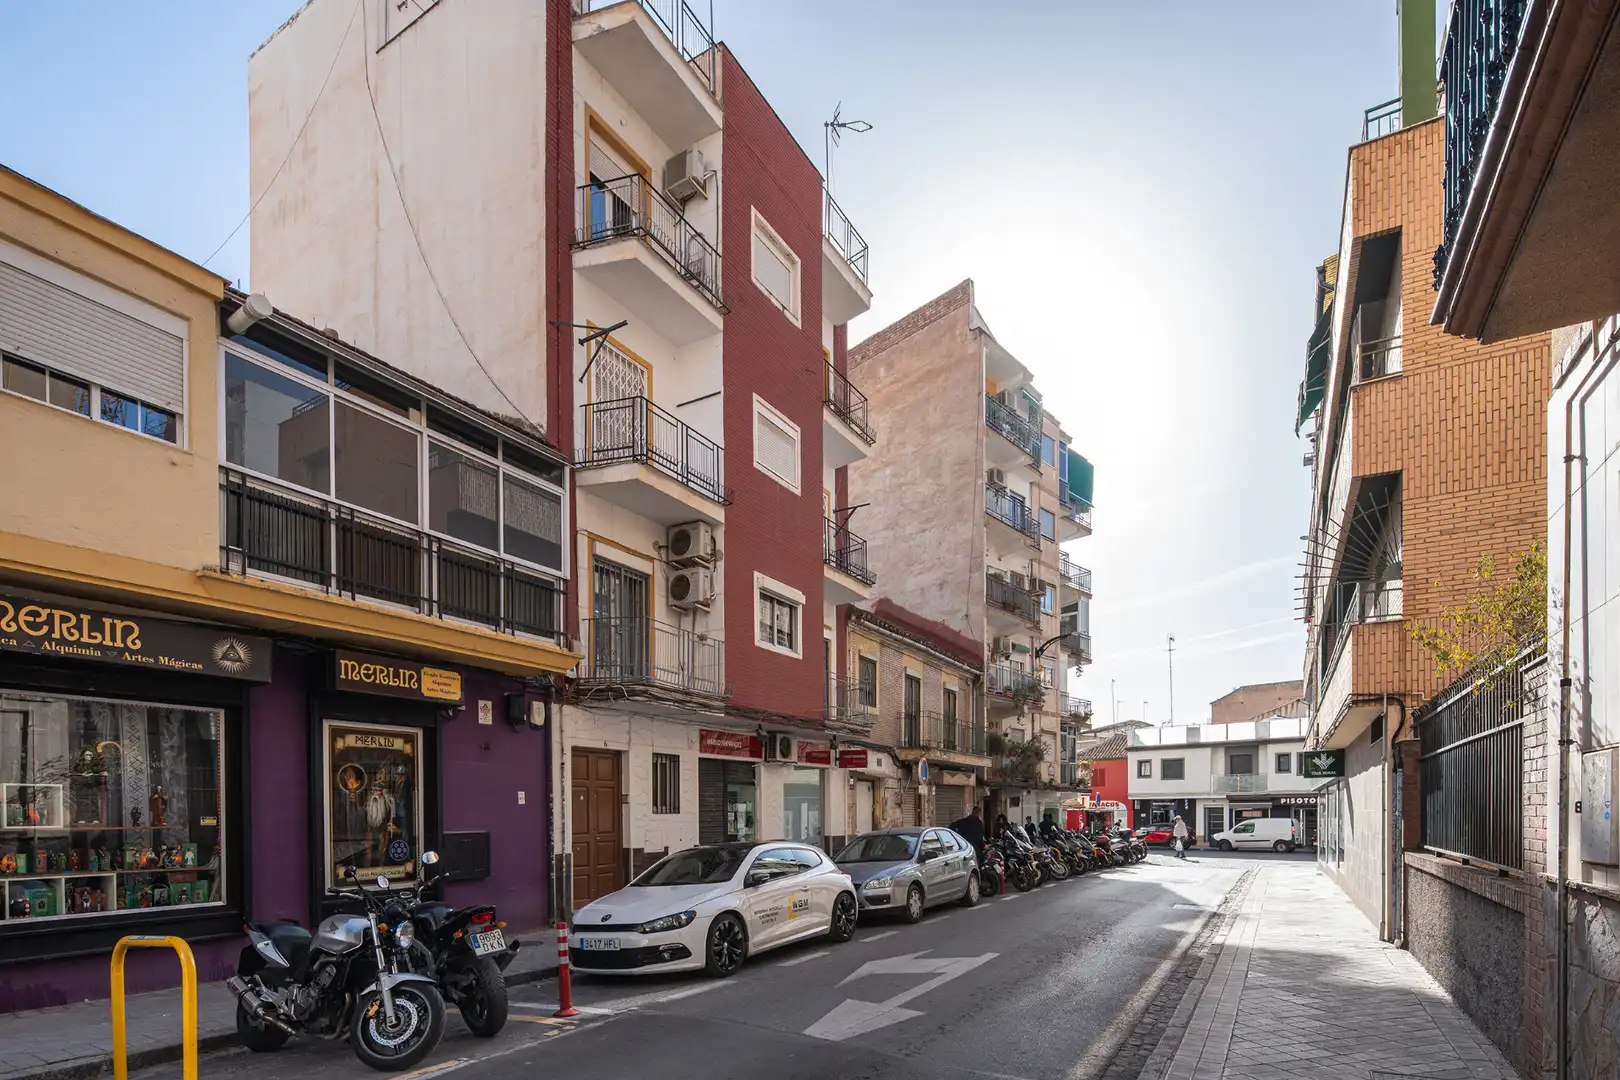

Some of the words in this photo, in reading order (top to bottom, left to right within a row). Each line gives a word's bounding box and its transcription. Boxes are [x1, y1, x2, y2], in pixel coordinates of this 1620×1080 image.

[0, 637, 17, 647] ca
[41, 640, 102, 657] Alquimia
[122, 652, 155, 664] Artes
[158, 655, 203, 670] Mágicas
[340, 659, 418, 689] MERLIN
[355, 735, 395, 748] MERLIN
[1089, 801, 1120, 809] TAACOS
[483, 939, 504, 953] DKN
[585, 939, 602, 949] 3417
[603, 939, 619, 949] HFL
